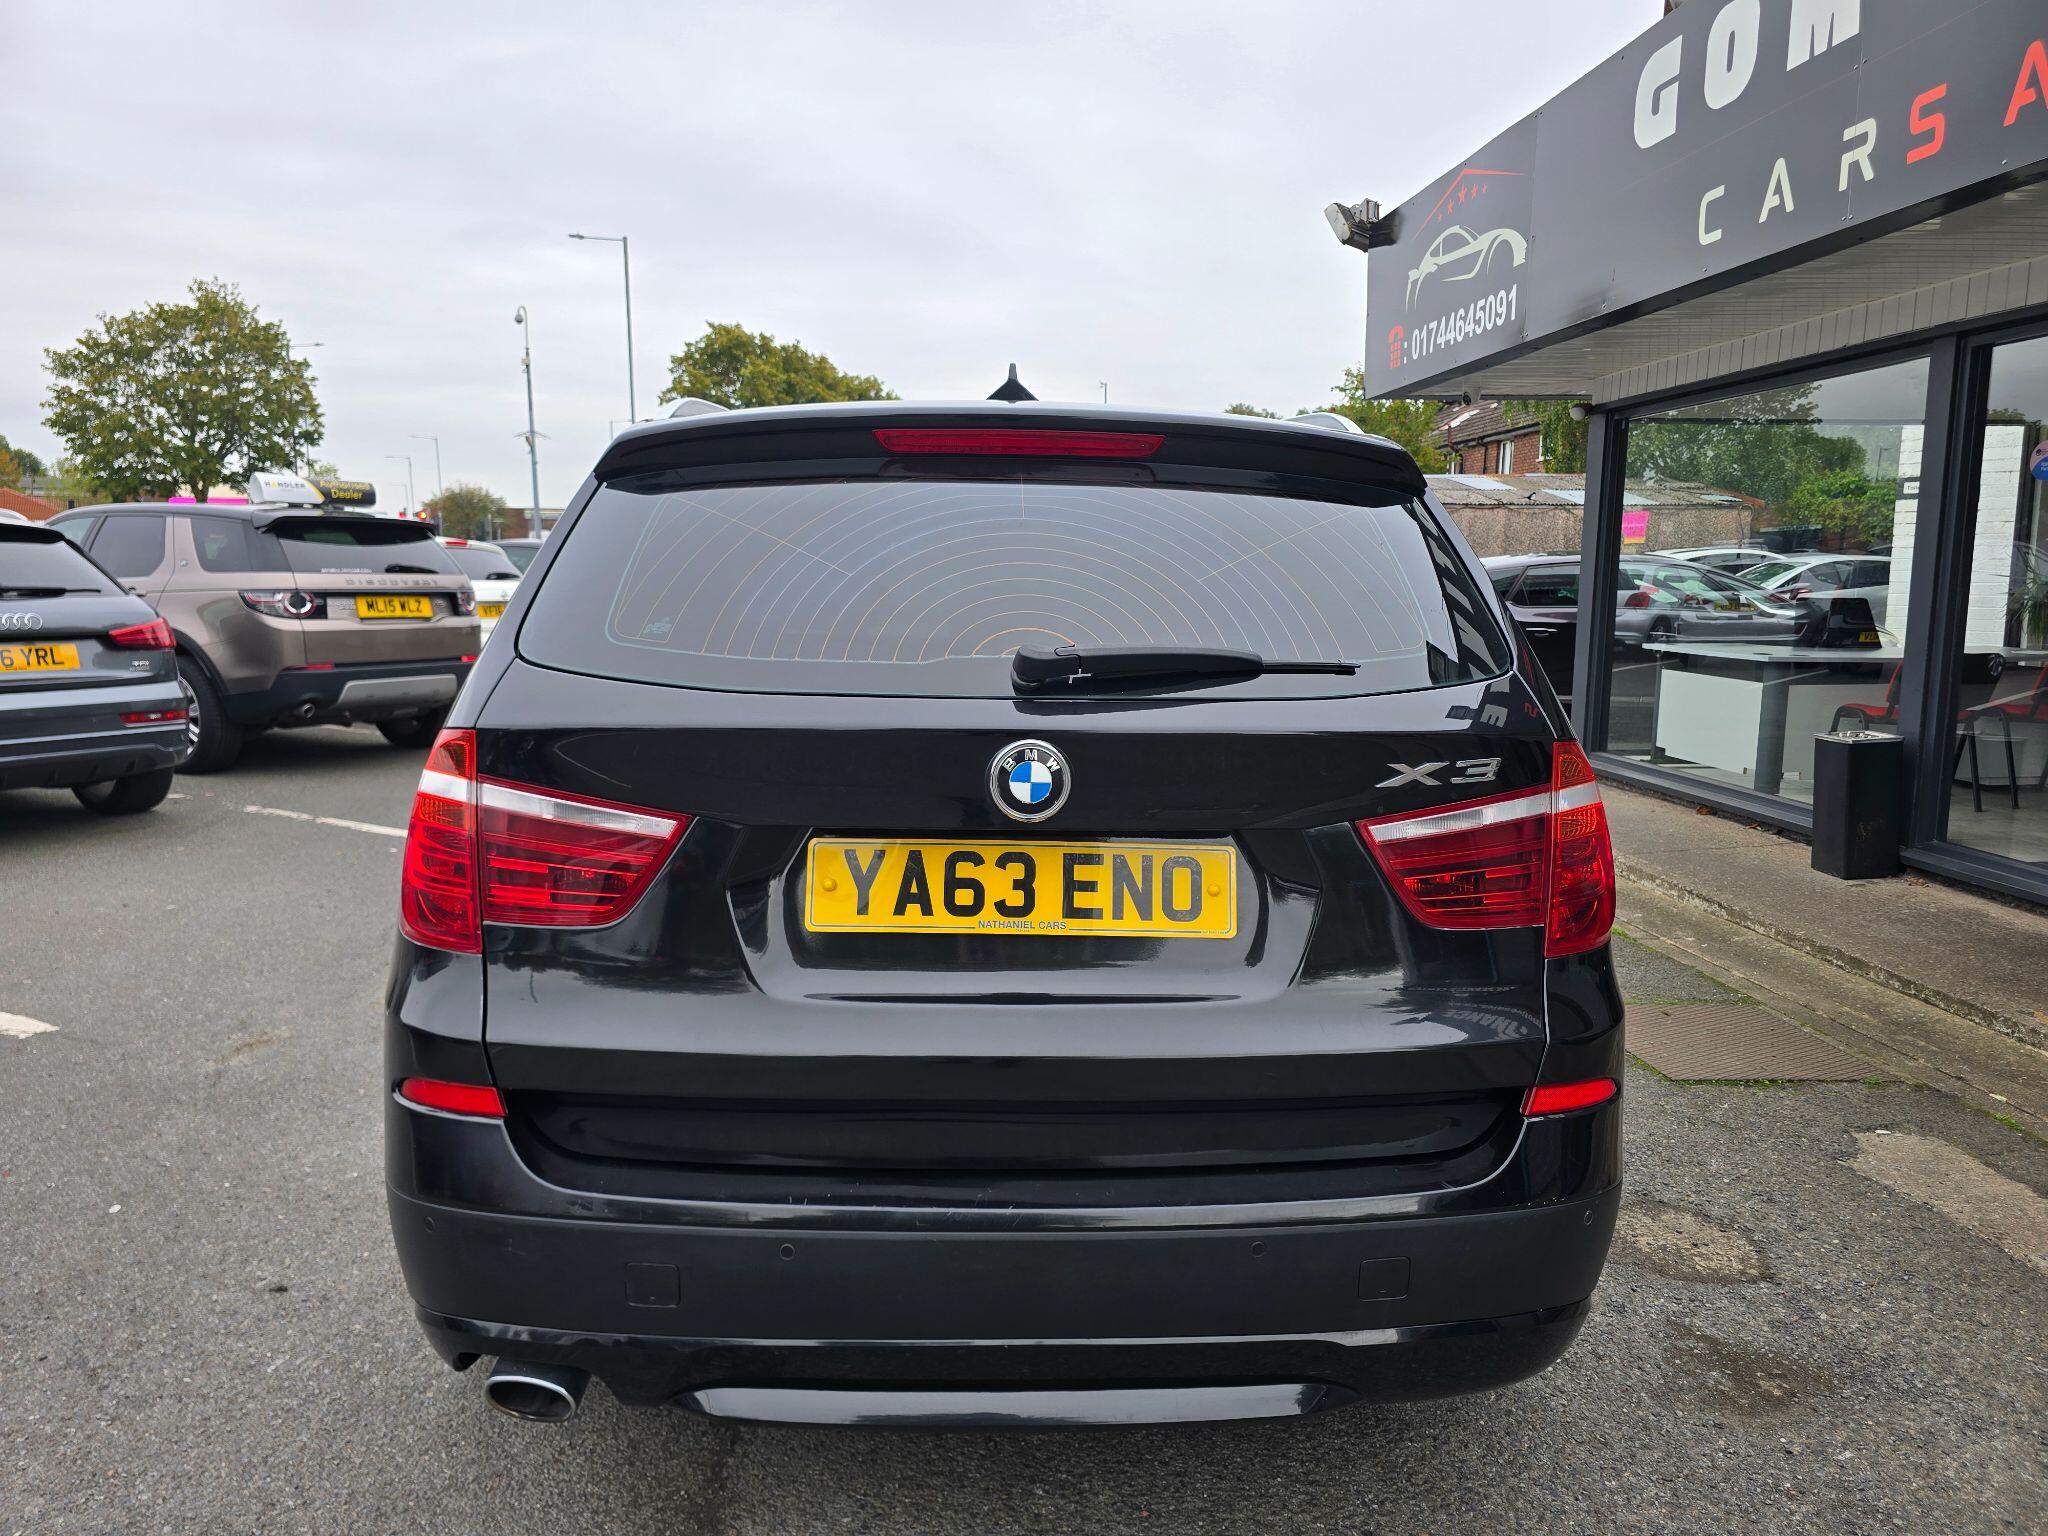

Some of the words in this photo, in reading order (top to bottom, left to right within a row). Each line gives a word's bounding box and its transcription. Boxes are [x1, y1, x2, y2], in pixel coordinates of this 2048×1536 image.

[1411, 283, 1517, 360] 01744645091
[331, 489, 363, 500] Dealer
[366, 599, 396, 613] ML15
[399, 599, 423, 613] WLZ
[20, 648, 65, 666] YRL
[1002, 749, 1061, 772] BMW
[1374, 757, 1501, 788] X3
[843, 849, 1037, 918] YA63
[1062, 852, 1203, 922] ENO
[978, 920, 1035, 929] NATHANIEL
[1038, 921, 1067, 930] CARS
